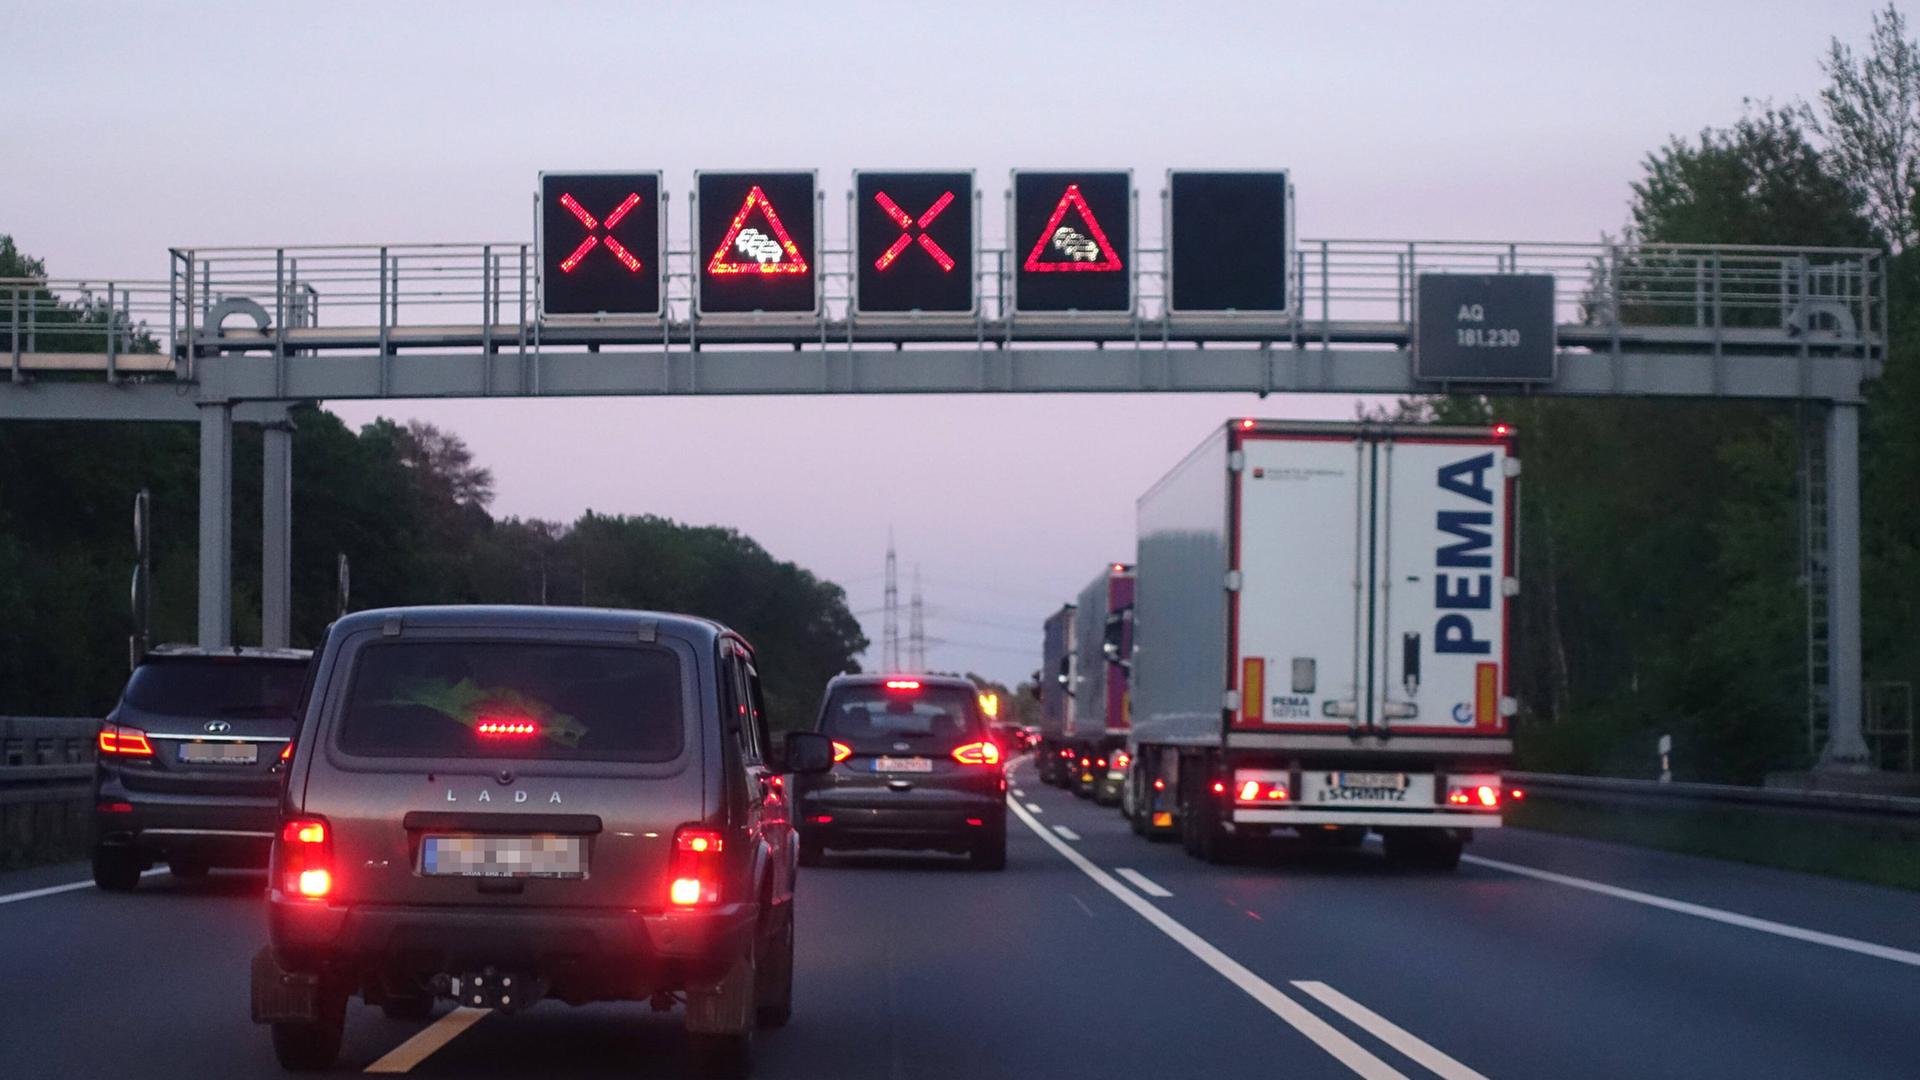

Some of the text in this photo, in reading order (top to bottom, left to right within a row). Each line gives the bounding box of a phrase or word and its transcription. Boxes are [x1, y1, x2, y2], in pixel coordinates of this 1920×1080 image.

[1457, 303, 1485, 322] AQ
[1457, 328, 1521, 347] 181.230
[1434, 452, 1494, 654] PEMA
[1271, 696, 1310, 706] PEMA
[447, 789, 562, 804] LADA
[1328, 787, 1406, 802] SCHMITZ
